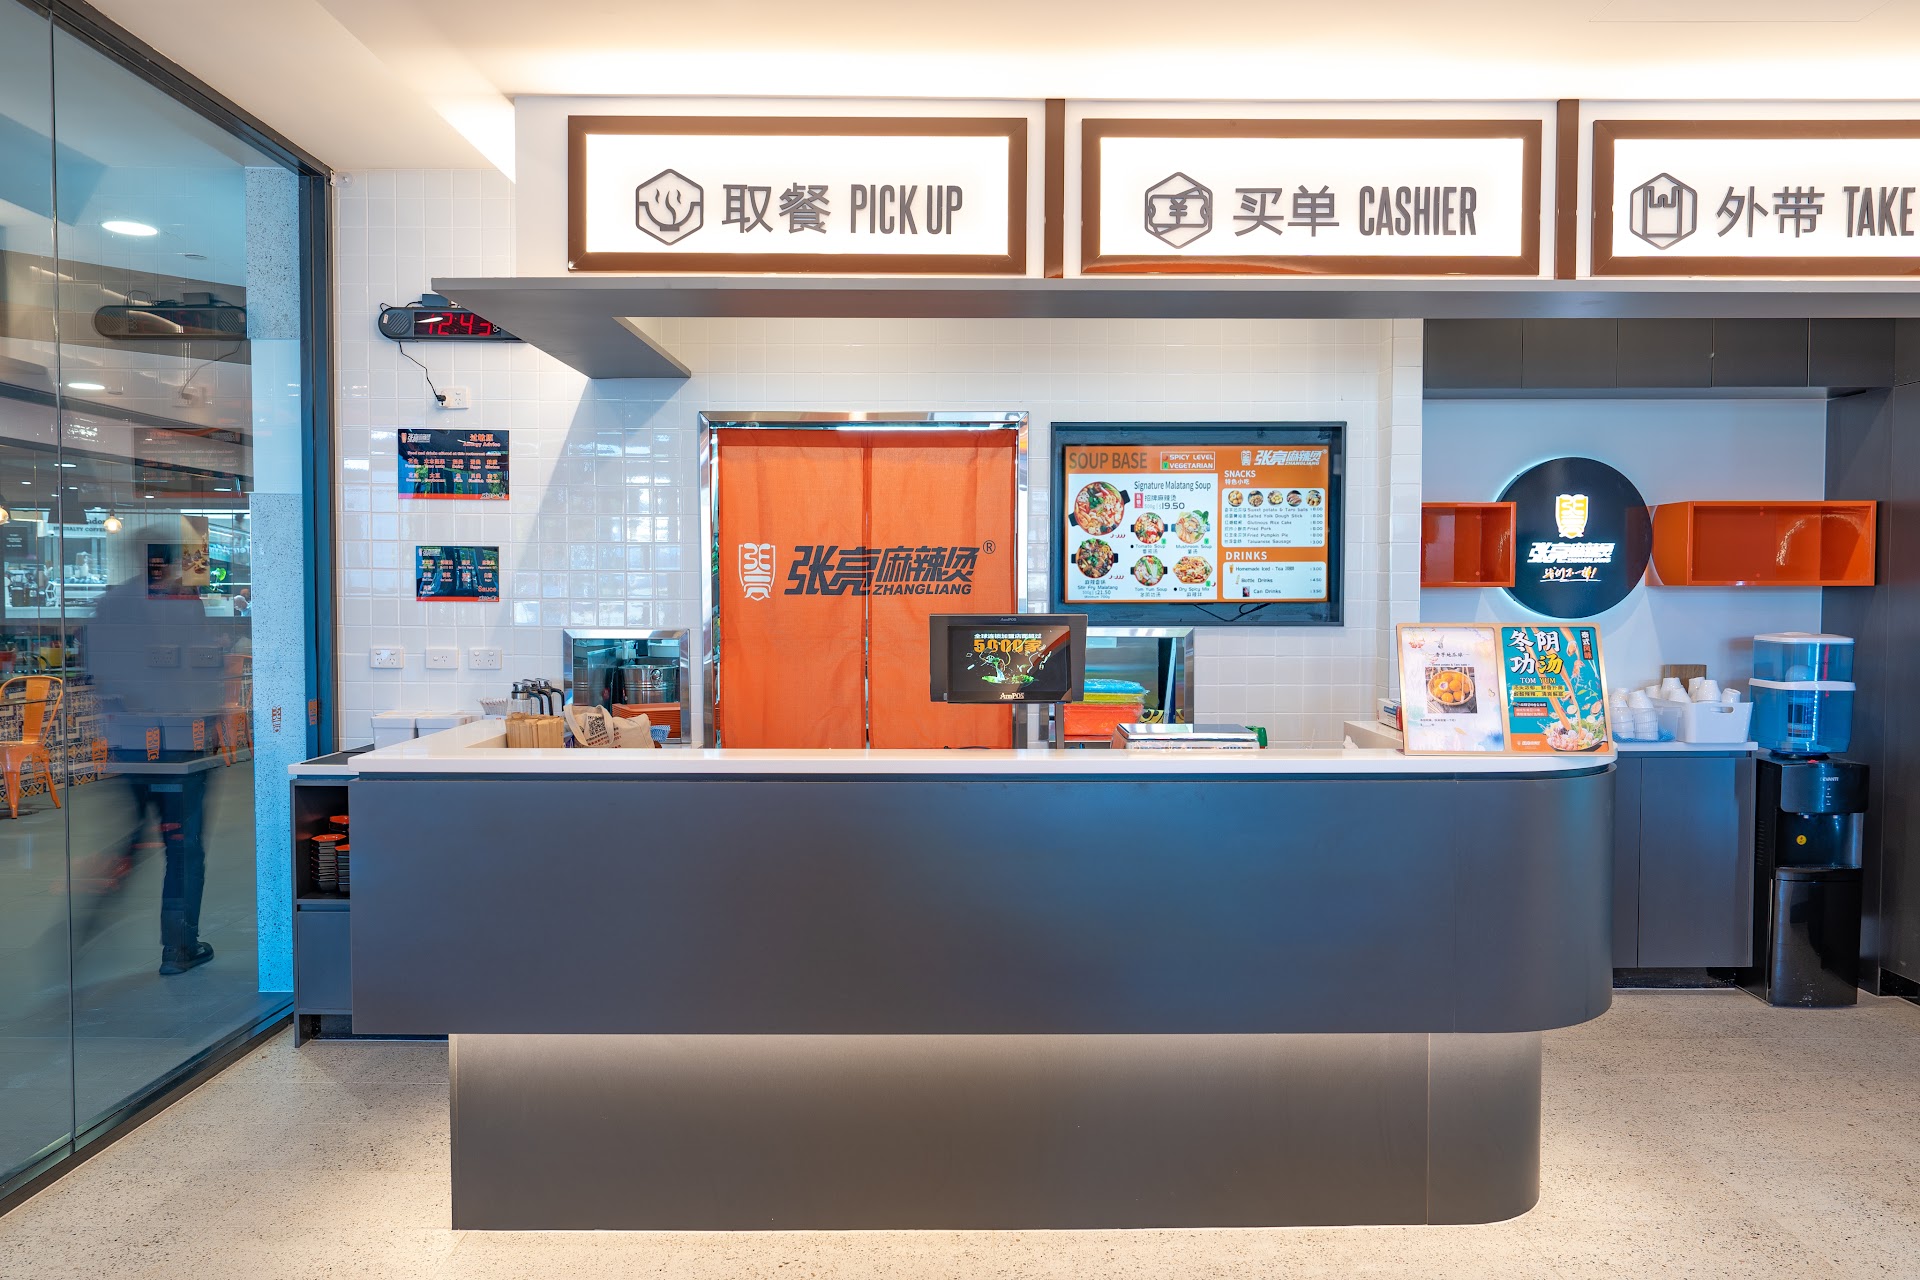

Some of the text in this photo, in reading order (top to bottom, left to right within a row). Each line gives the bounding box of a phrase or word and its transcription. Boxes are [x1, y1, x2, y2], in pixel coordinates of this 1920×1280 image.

[722, 182, 963, 235] 取餐 PICK UP
[1233, 185, 1477, 237] 买单 CASHIER
[1716, 186, 1916, 238] 外带 TAKE
[1069, 452, 1147, 469] SOUP BASE
[1224, 470, 1256, 478] SNACKS
[1134, 481, 1212, 491] Signature Malatang Soup
[1225, 551, 1268, 560] DRINKS
[784, 545, 981, 596] 张亮麻辣烫
[873, 583, 972, 595] ZHANGLIANG
[1508, 630, 1560, 652] 冬阴
[1510, 653, 1563, 674] 功汤
